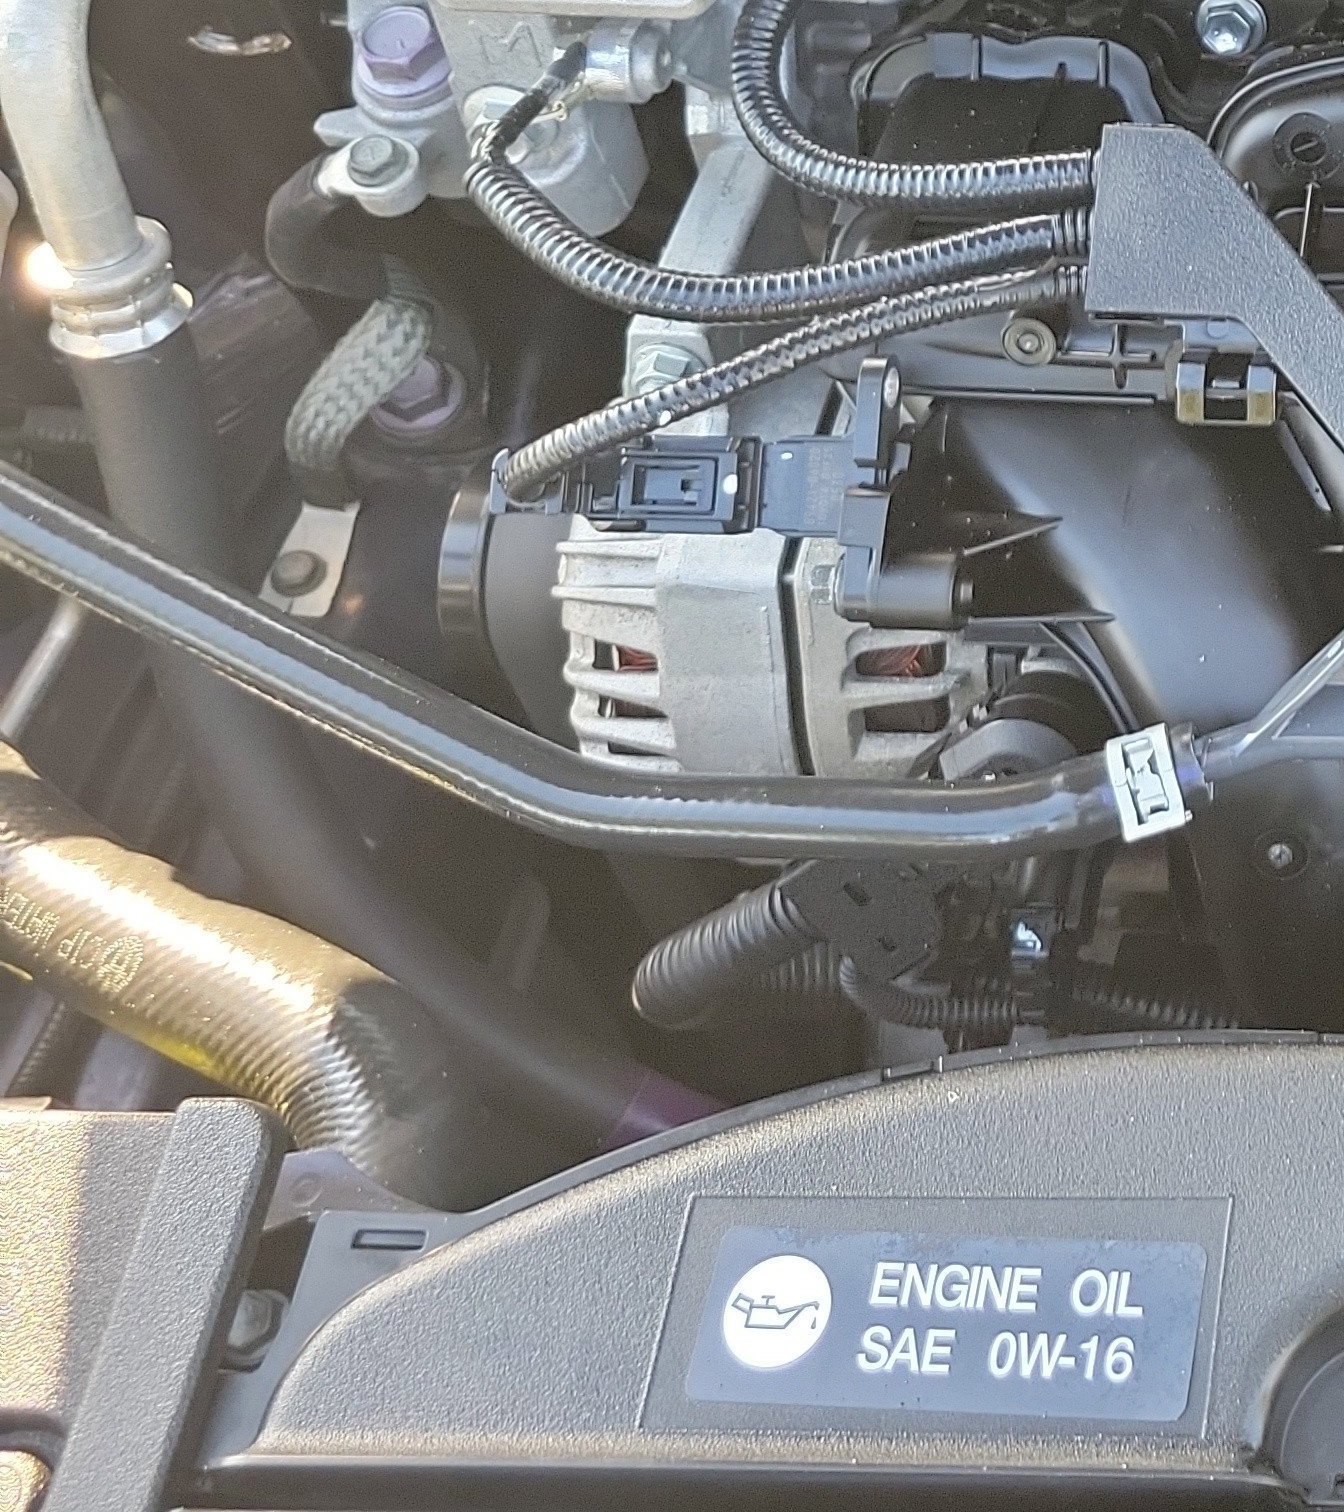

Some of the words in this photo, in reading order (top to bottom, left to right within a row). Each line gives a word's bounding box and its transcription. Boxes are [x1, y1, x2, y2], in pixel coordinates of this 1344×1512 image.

[869, 1261, 1041, 1313] ENGINE
[1071, 1268, 1144, 1317] OIL
[857, 1326, 956, 1375] SAE
[987, 1333, 1135, 1383] 0W-16
